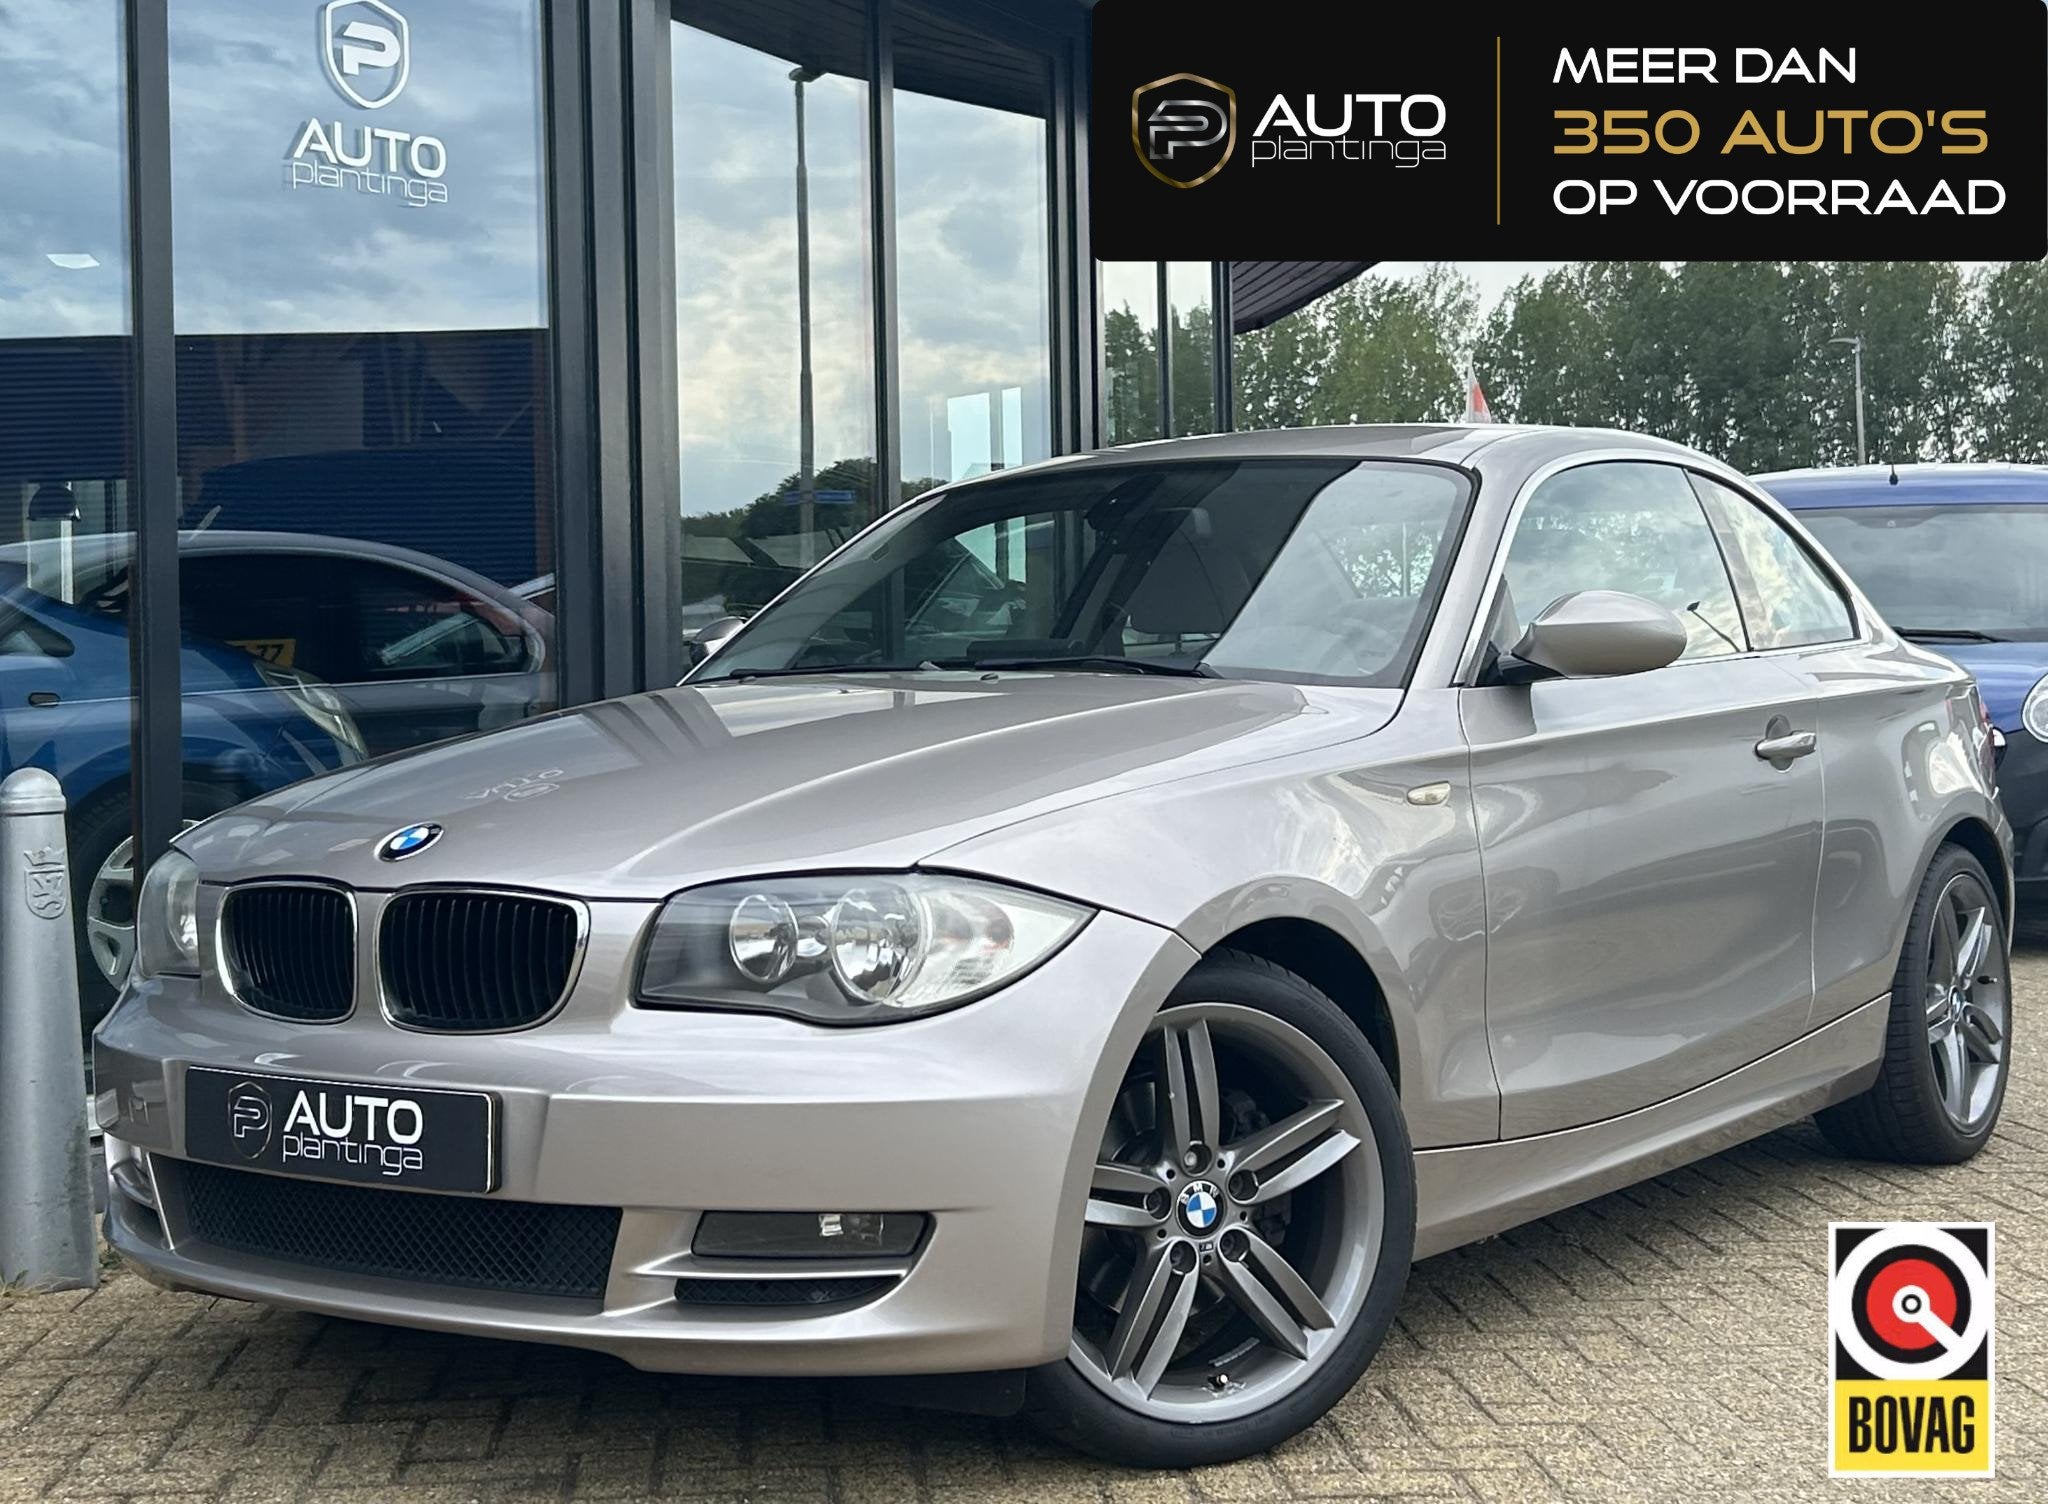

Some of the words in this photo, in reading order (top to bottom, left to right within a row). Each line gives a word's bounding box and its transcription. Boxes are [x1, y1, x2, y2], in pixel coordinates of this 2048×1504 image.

[293, 117, 448, 179] AUTO
[292, 159, 449, 208] plantinga
[283, 1089, 424, 1145] AUTO
[282, 1131, 423, 1176] plantinga
